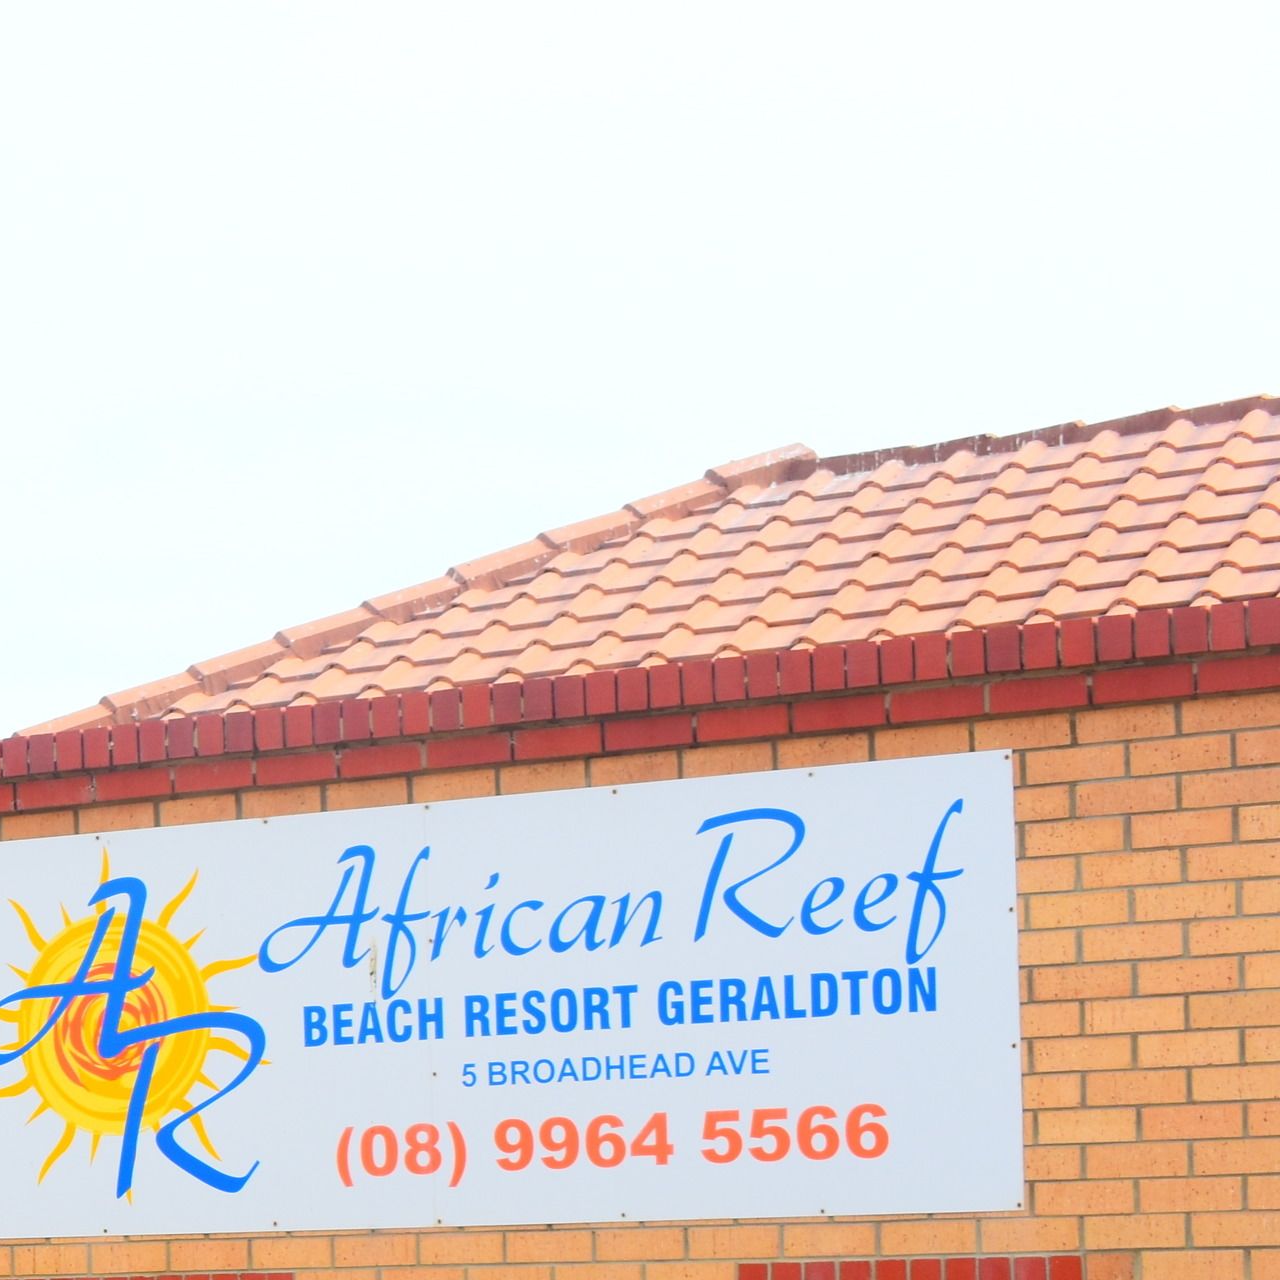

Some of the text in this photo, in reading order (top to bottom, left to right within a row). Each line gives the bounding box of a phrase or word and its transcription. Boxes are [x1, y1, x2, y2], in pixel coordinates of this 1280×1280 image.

[258, 799, 965, 1000] African Reef
[303, 966, 938, 1047] BEACH RESORT GERALDTON
[461, 1049, 770, 1087] 5 BROADHEAD AVE
[337, 1104, 889, 1187] (08) 9964 5566
